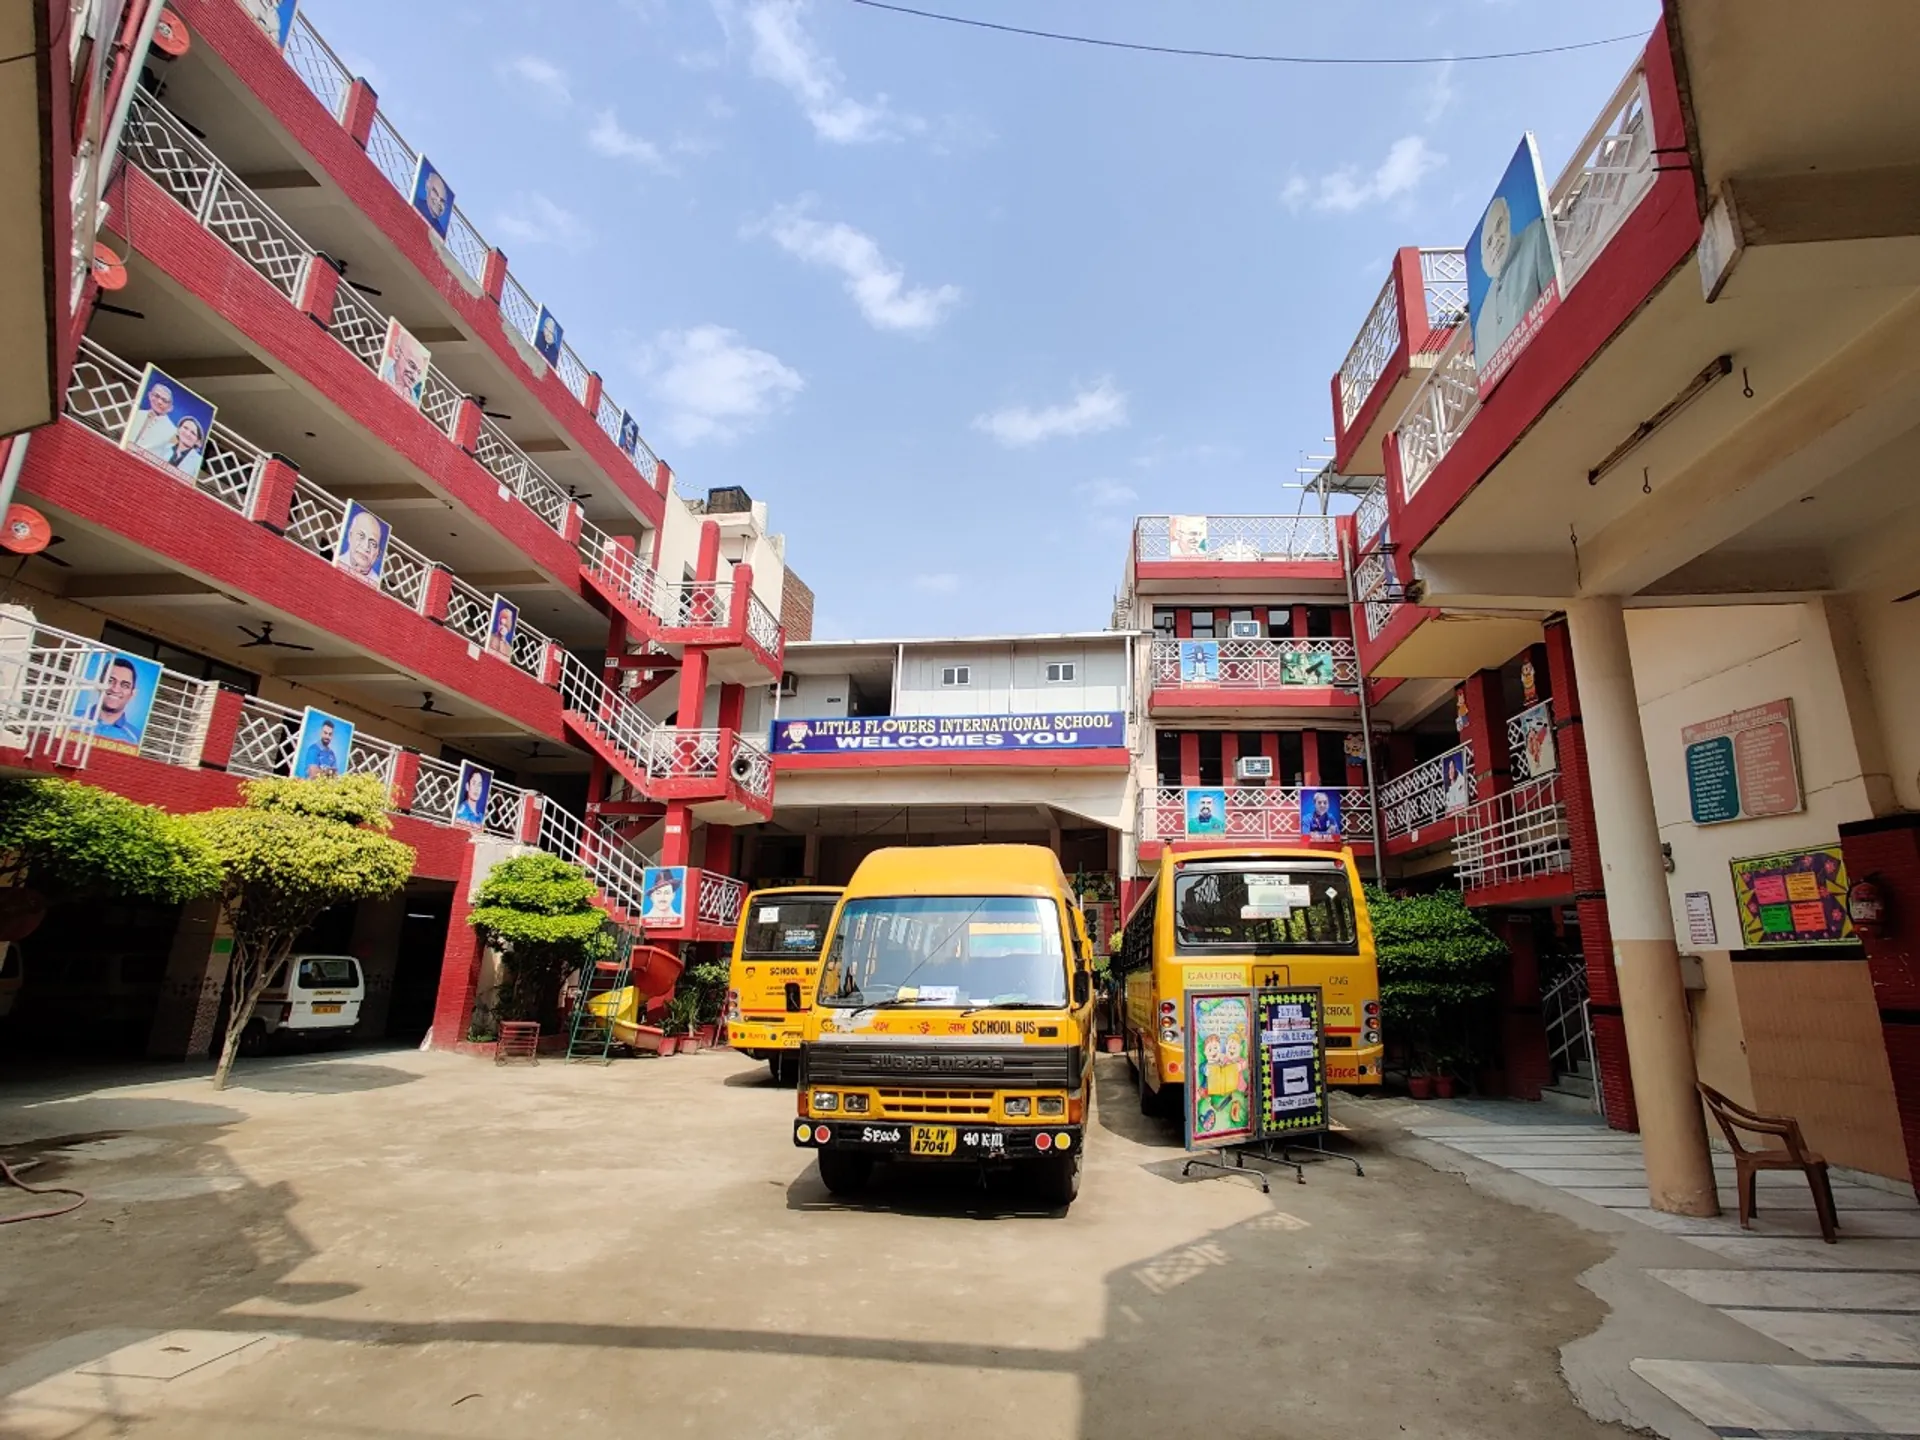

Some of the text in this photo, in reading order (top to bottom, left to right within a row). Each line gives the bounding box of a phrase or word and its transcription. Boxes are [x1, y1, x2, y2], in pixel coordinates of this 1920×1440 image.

[1479, 282, 1556, 386] NARENDRA MODI
[815, 714, 1113, 736] LITTLE FLOWERS INTERNATIONAL SCHOOL
[835, 731, 1078, 748] WELCOMES YOU
[769, 967, 799, 977] SCHOOL
[1187, 972, 1242, 982] CAUTION
[1329, 976, 1349, 986] CNG
[1324, 1006, 1353, 1017] CHOOL
[972, 1020, 1036, 1034] SCHOOL BUS
[914, 1140, 949, 1153] A7041
[963, 1132, 1004, 1148] 40 KM
